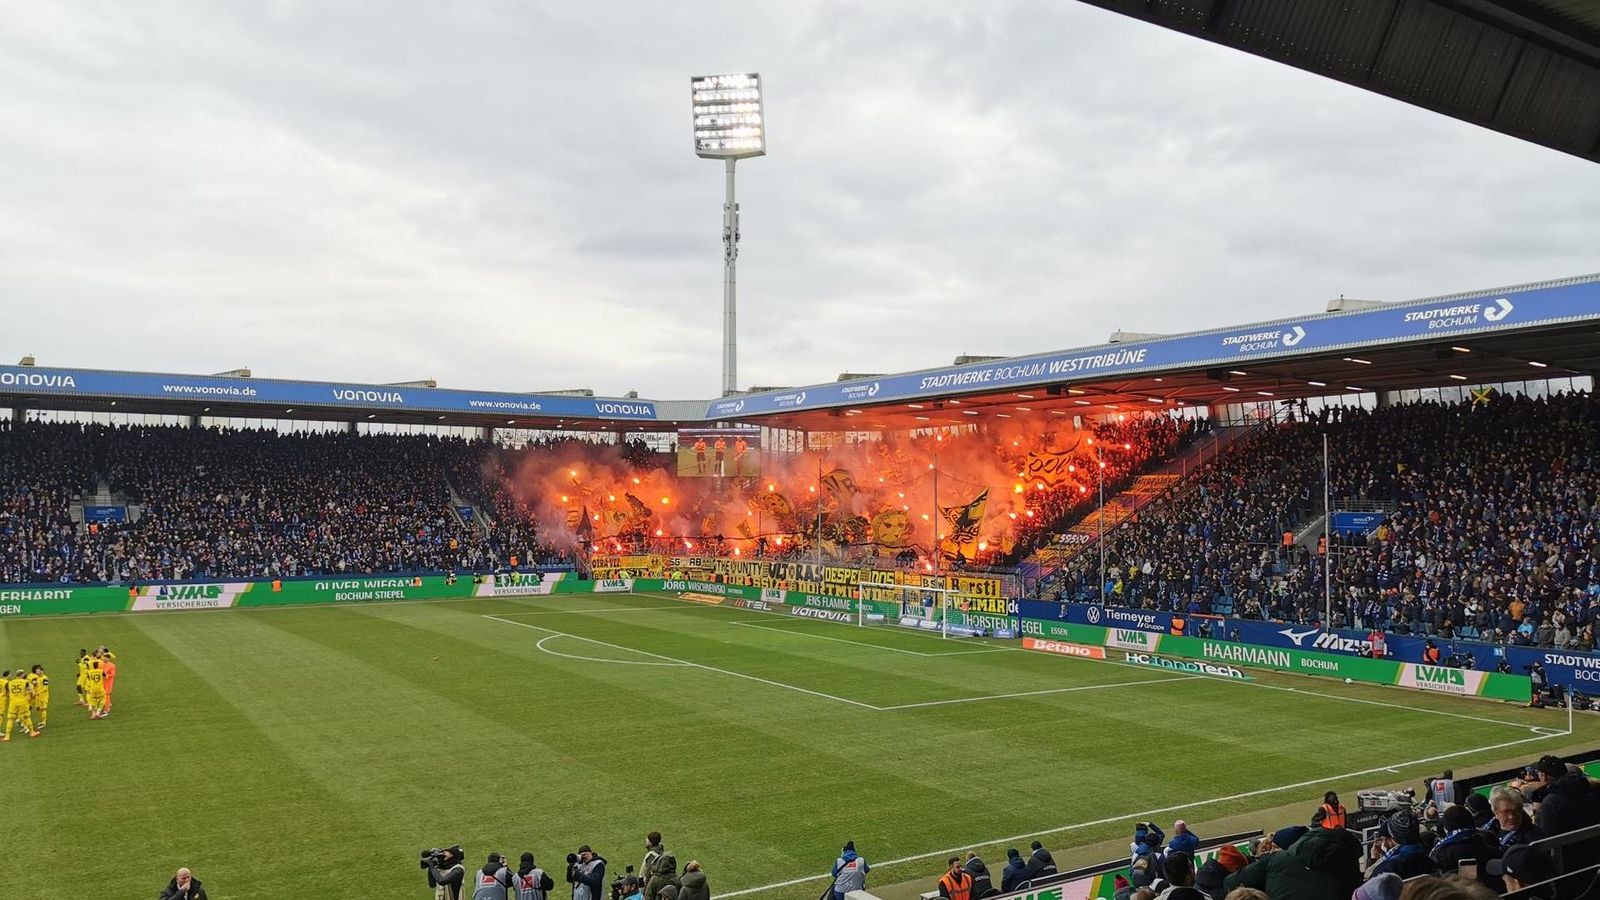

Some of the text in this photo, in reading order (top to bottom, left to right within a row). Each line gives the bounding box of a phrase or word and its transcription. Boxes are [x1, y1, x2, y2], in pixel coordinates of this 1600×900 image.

[1404, 303, 1481, 322] STADTWERKE
[1428, 315, 1477, 329] BOCHUM
[1222, 330, 1280, 346] STADTWERKE
[1239, 340, 1278, 352] BOCHUM
[919, 348, 1148, 390] STADTWERKE BOCHUM WESTTRIBÜNE
[0, 373, 76, 387] ONOVIA
[163, 384, 257, 396] www.vonovia.de
[469, 400, 542, 410] www.vonovia.de
[717, 560, 730, 572] THE
[738, 561, 762, 575] UNITY
[364, 579, 423, 588] WIEGAN
[799, 581, 880, 601] DORTMND
[951, 578, 997, 597] Brsti
[335, 590, 405, 601] BOCHUM STIEPEL
[805, 595, 821, 606] JENS
[822, 596, 851, 610] FLAMME
[156, 600, 218, 608] VERSICHERUNG
[953, 595, 1006, 614] WIMAR
[962, 614, 1007, 630] THORSTEN
[1011, 620, 1045, 635] REGEL
[1051, 627, 1068, 635] ESSEN
[1105, 608, 1156, 627] Tiemeyer
[1116, 629, 1138, 643] LVM
[1033, 639, 1091, 656] Betano
[1312, 633, 1388, 656] MIZ
[1203, 642, 1338, 671] HAARMANN BOCHUM
[1415, 665, 1449, 683] LVM
[12, 684, 22, 693] 25
[1416, 682, 1465, 692] VERSICHERUNG
